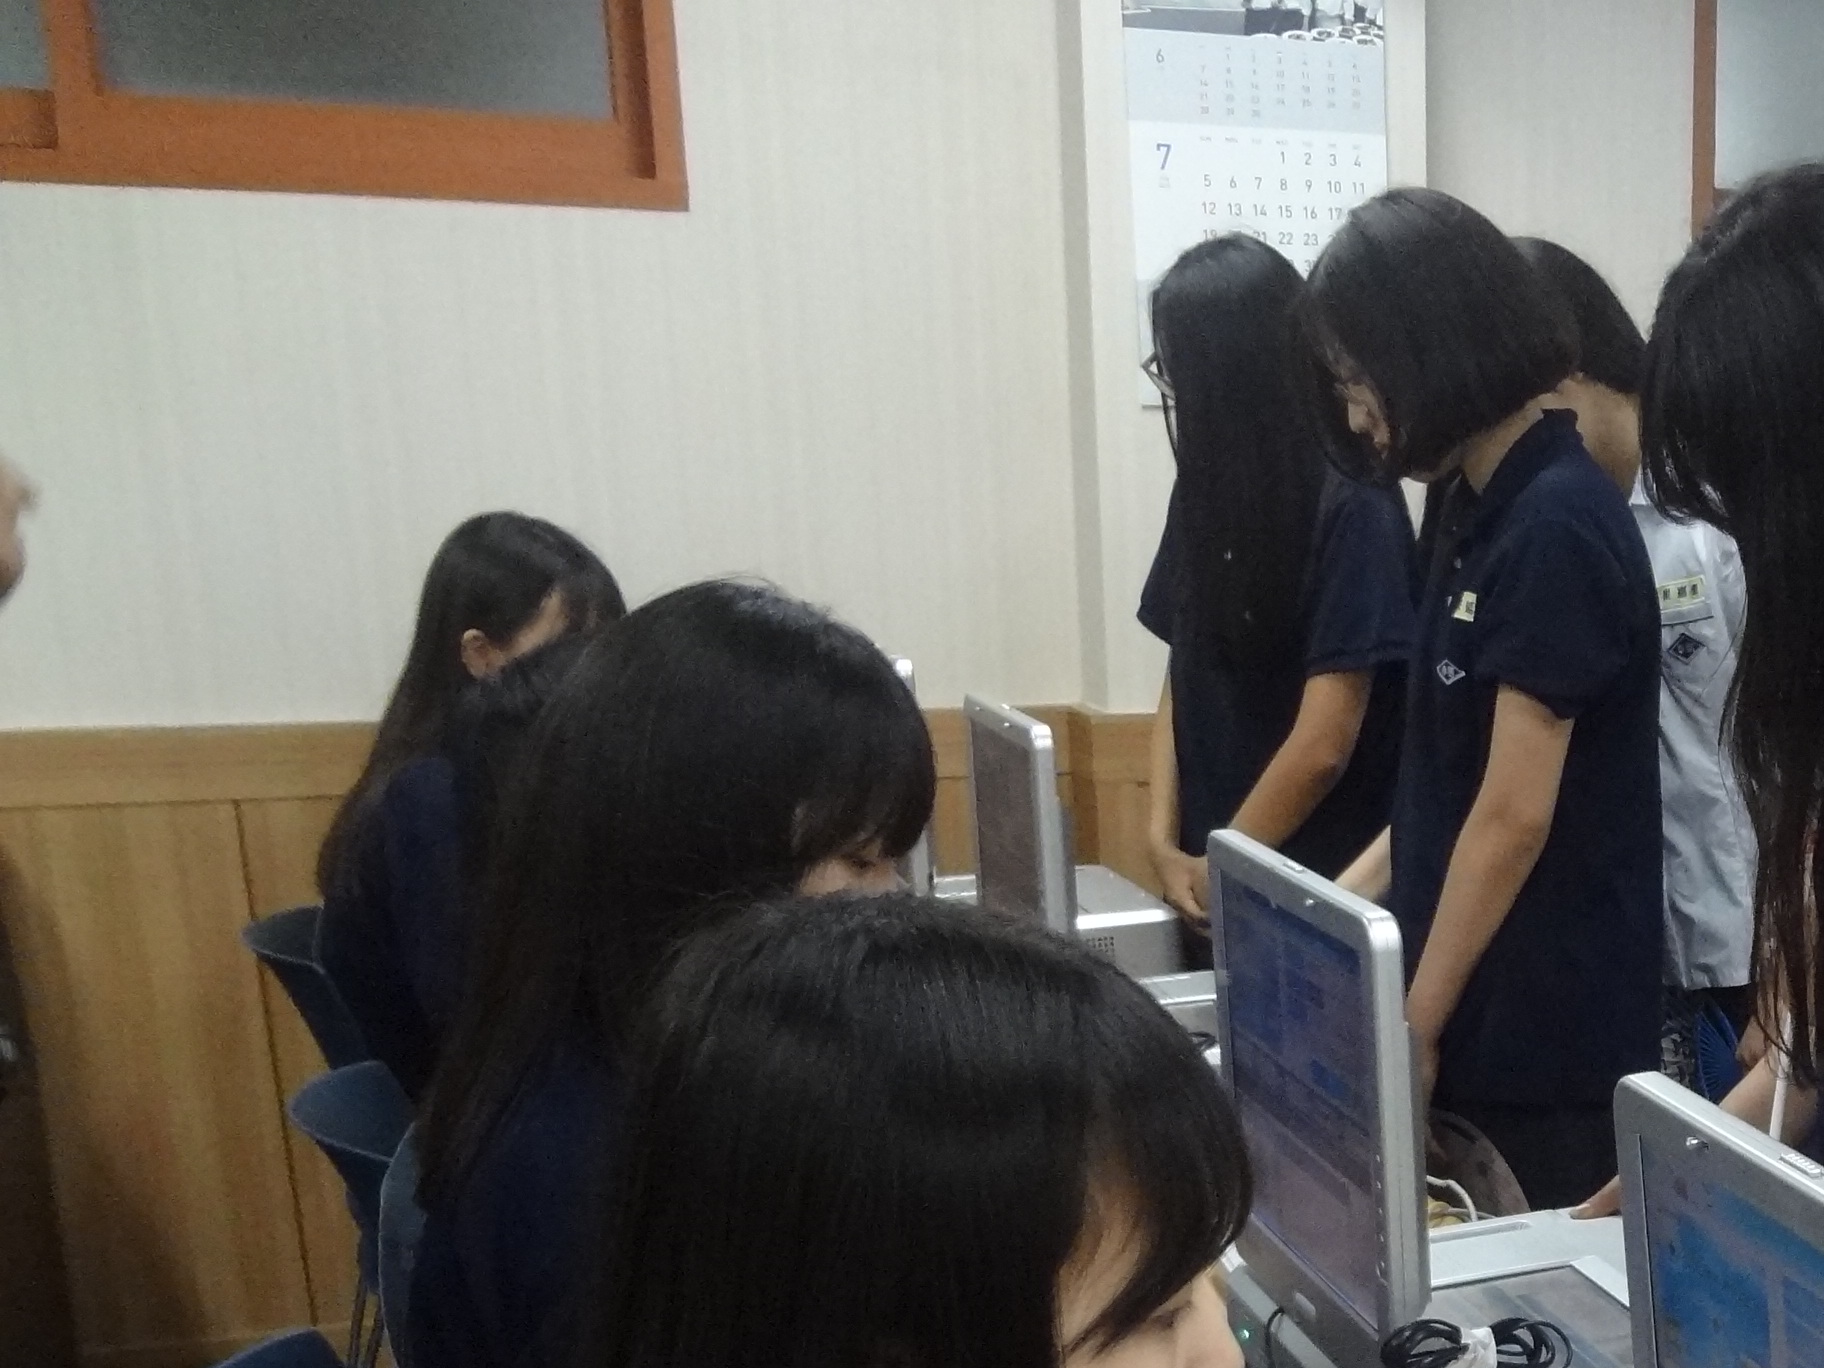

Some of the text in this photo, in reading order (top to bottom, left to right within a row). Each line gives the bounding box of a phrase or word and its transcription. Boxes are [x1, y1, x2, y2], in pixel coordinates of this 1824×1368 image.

[1156, 49, 1165, 64] 6
[1156, 143, 1171, 170] 7
[1304, 152, 1312, 165] 2
[1329, 153, 1337, 166] 3
[1353, 155, 1361, 167] 4
[1203, 174, 1365, 194] 5 6 7 8 9 10 11
[1201, 201, 1342, 220] 12 13 14 15 16 17
[1278, 232, 1293, 245] 22
[1303, 233, 1319, 246] 23
